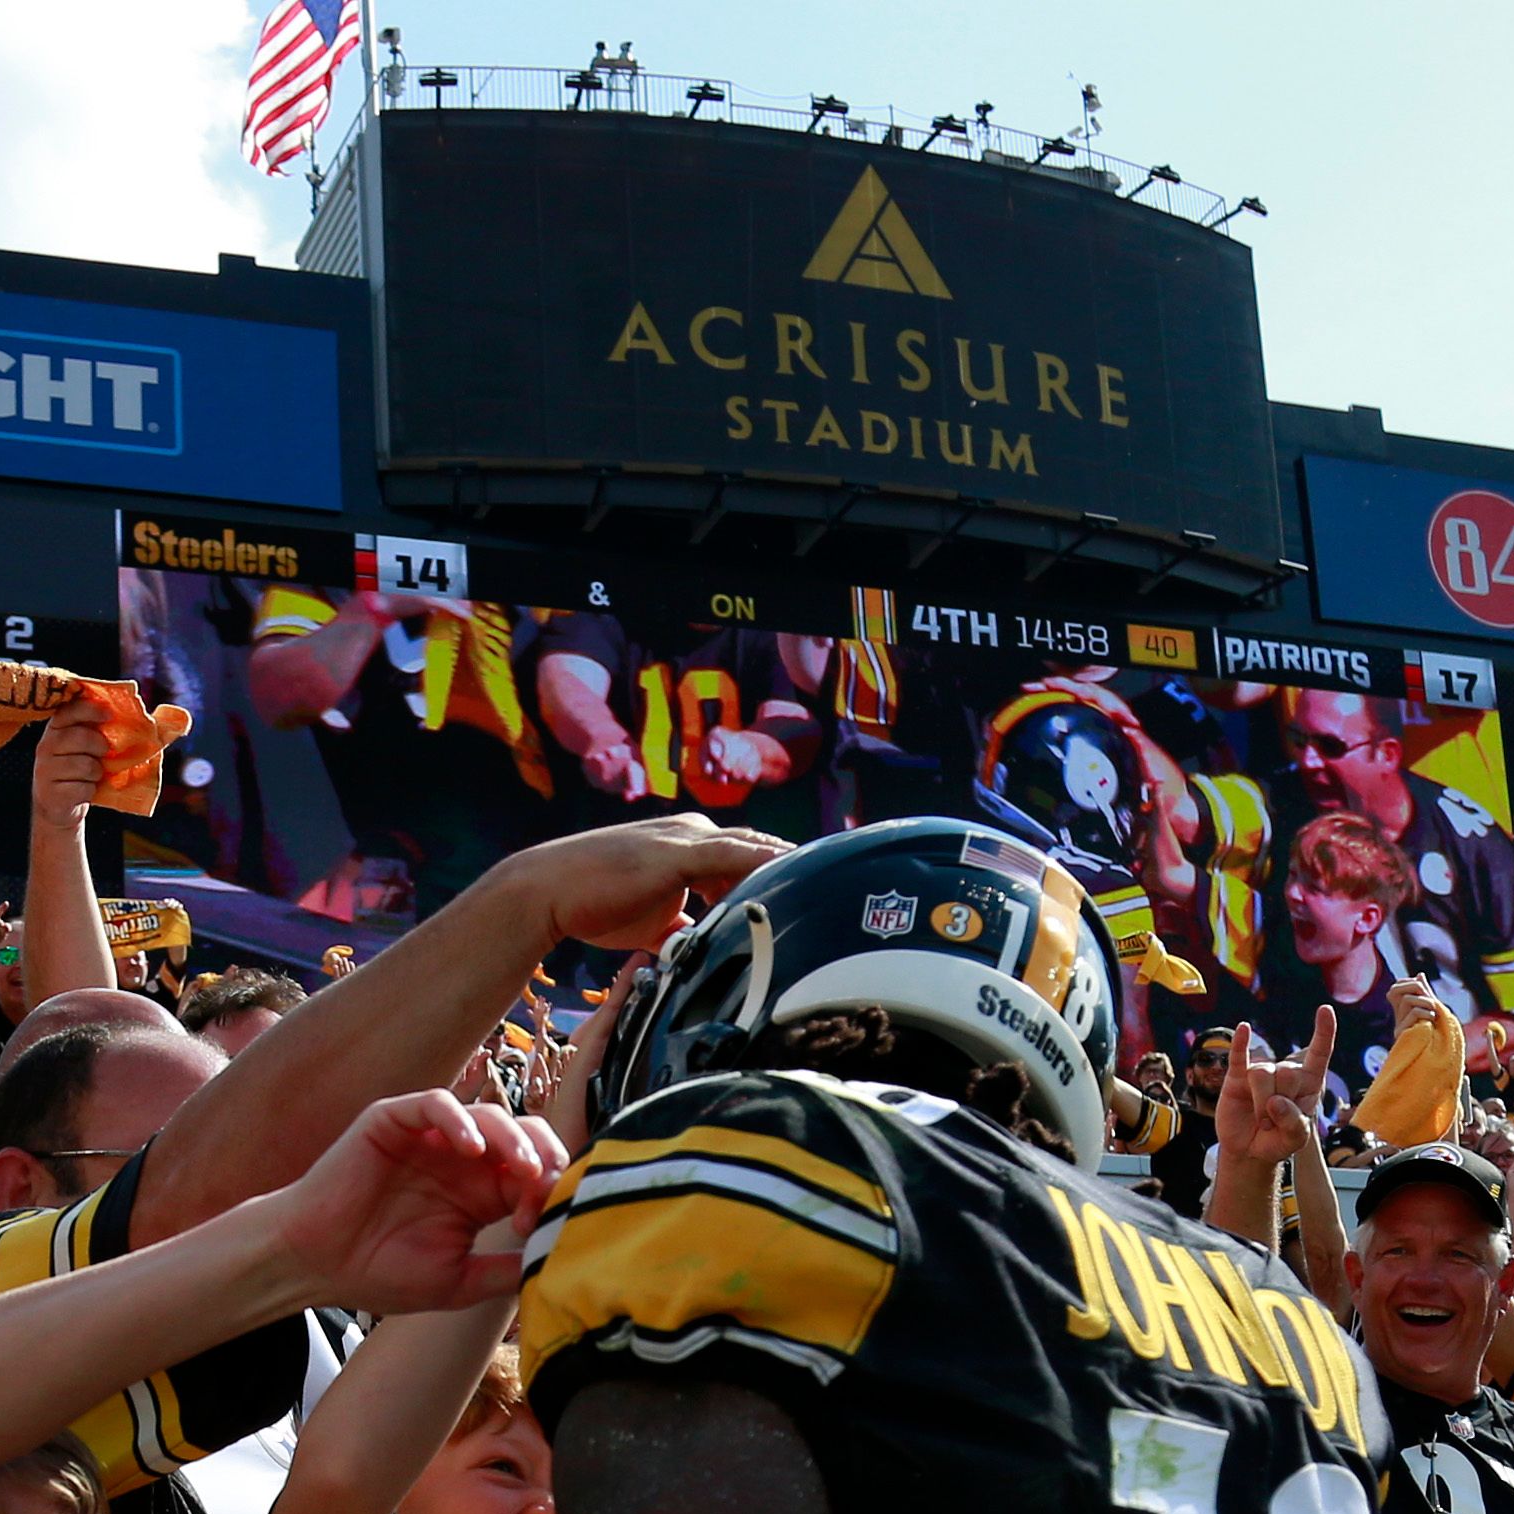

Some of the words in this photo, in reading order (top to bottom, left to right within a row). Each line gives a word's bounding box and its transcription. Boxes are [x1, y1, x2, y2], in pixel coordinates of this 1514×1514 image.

[607, 299, 1130, 429] ACRISURE
[726, 394, 1042, 478] STADIUM
[133, 520, 299, 579] Steelers
[394, 554, 451, 593] 14
[587, 581, 611, 608] &
[710, 592, 756, 622] ON
[4, 615, 35, 651] 2
[910, 603, 1000, 649] 4TH
[1014, 615, 1111, 657] 14:58
[1144, 633, 1180, 660] 40
[1224, 637, 1372, 689] PATRIOTS
[1438, 668, 1479, 703] 17
[869, 909, 907, 931] NFL
[943, 904, 973, 938] 3
[975, 982, 1078, 1089] Steelers
